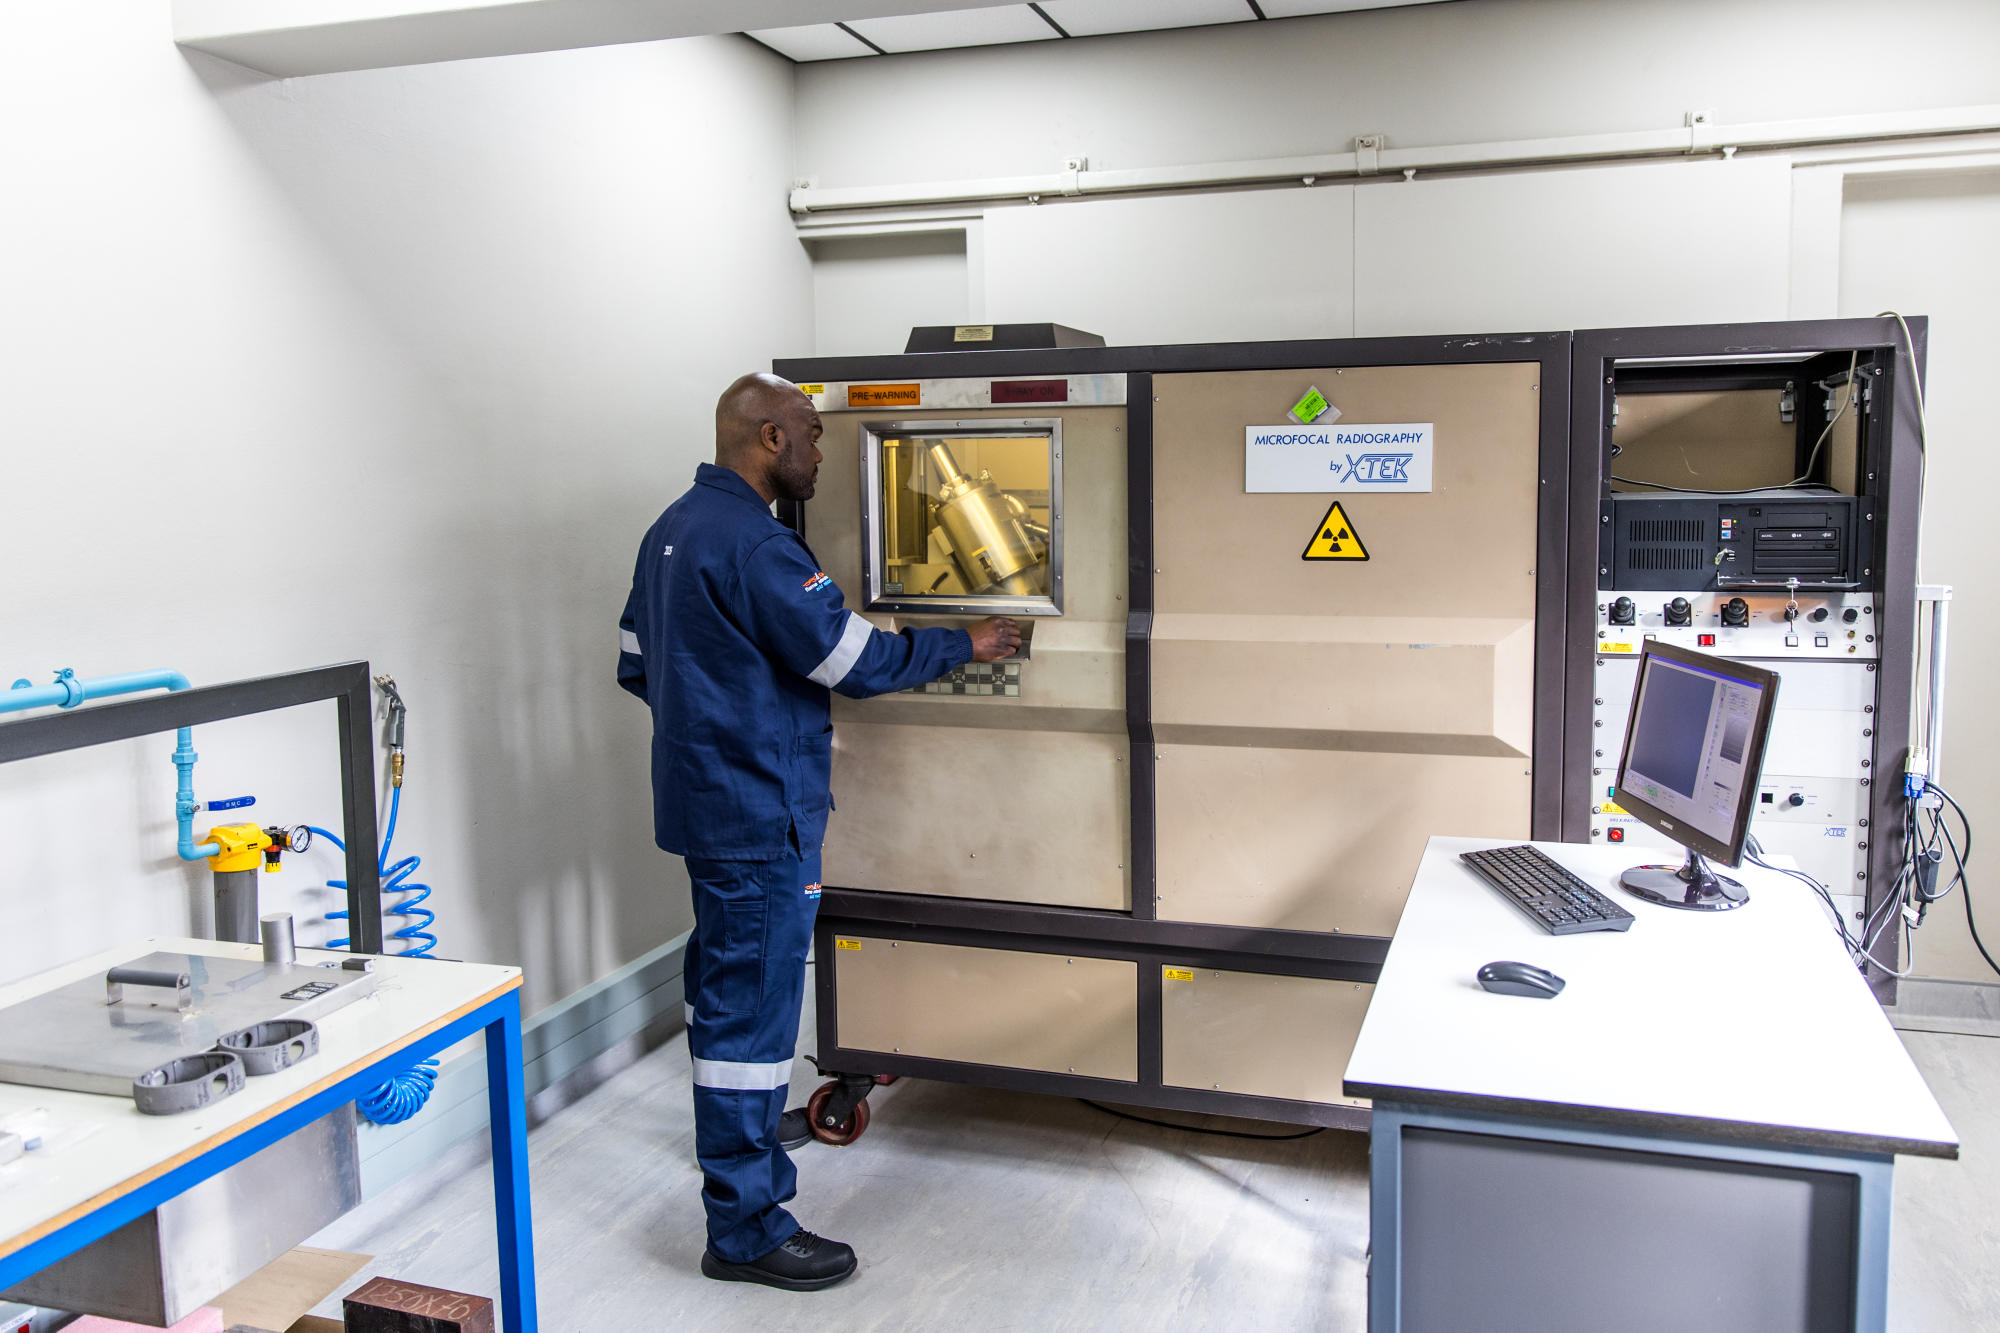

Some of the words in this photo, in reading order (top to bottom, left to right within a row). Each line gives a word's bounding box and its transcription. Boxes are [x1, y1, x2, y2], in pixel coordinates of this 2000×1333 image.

[852, 391, 917, 400] PRE-WARNING
[1040, 386, 1055, 395] ON
[1254, 434, 1330, 445] MICROFOCAL
[1336, 432, 1423, 444] RADIOGRAPHY
[1329, 460, 1343, 474] by
[1339, 453, 1414, 484] X-TEK
